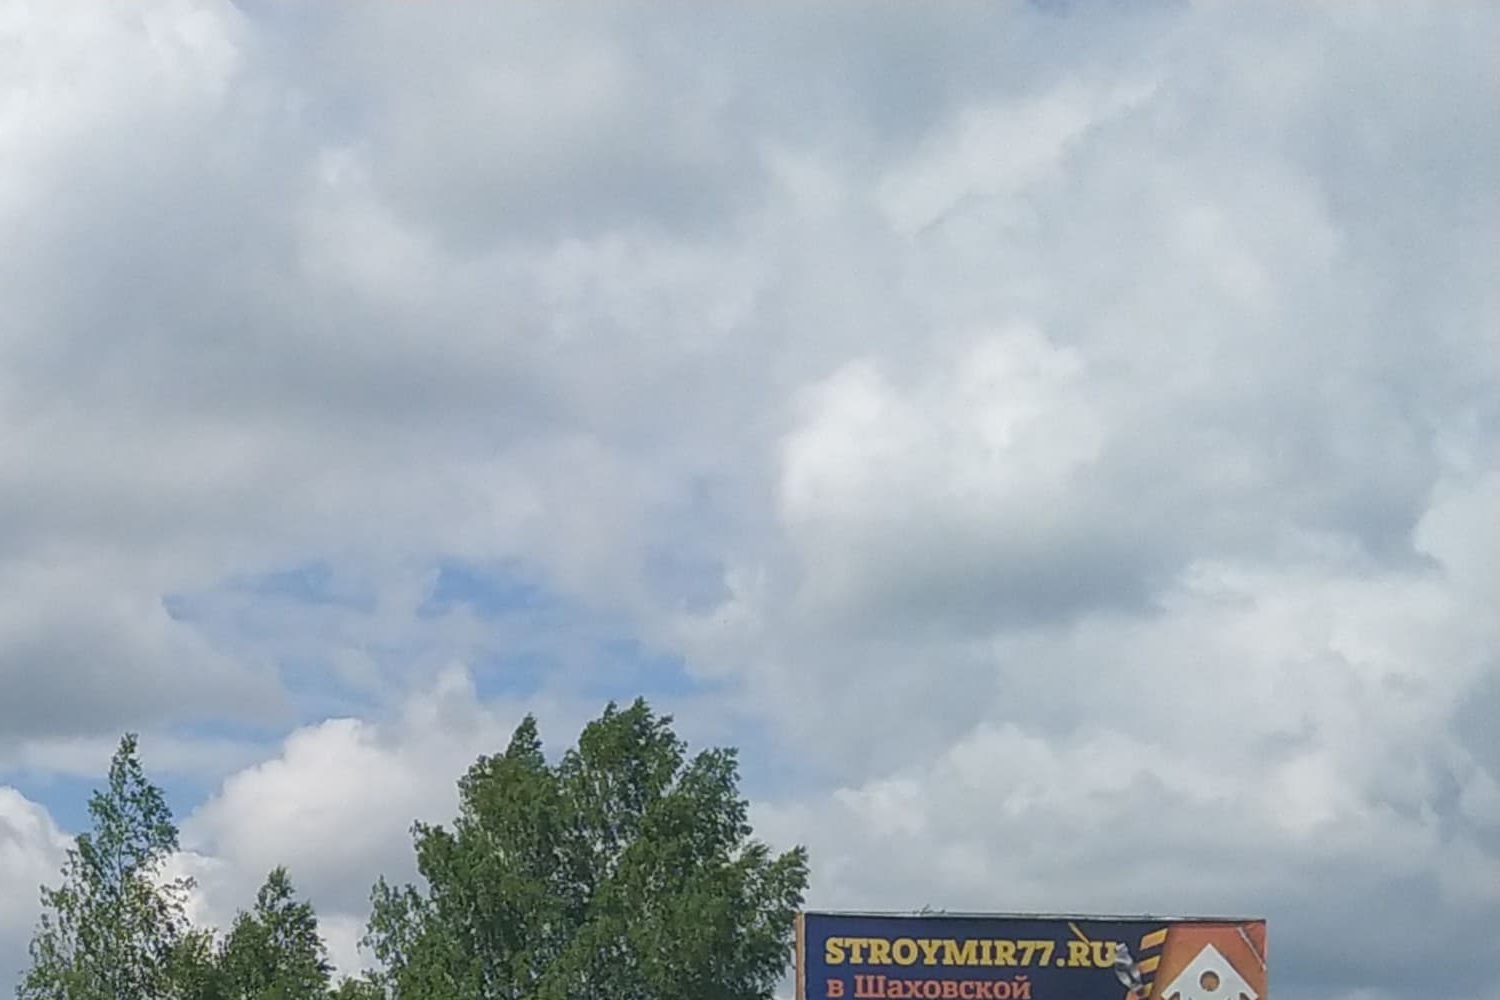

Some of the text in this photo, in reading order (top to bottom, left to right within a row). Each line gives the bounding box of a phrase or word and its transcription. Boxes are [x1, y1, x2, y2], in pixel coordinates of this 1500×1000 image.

[825, 936, 1117, 968] STROYMIR77.RU
[827, 974, 1031, 1000] в Шаховской
